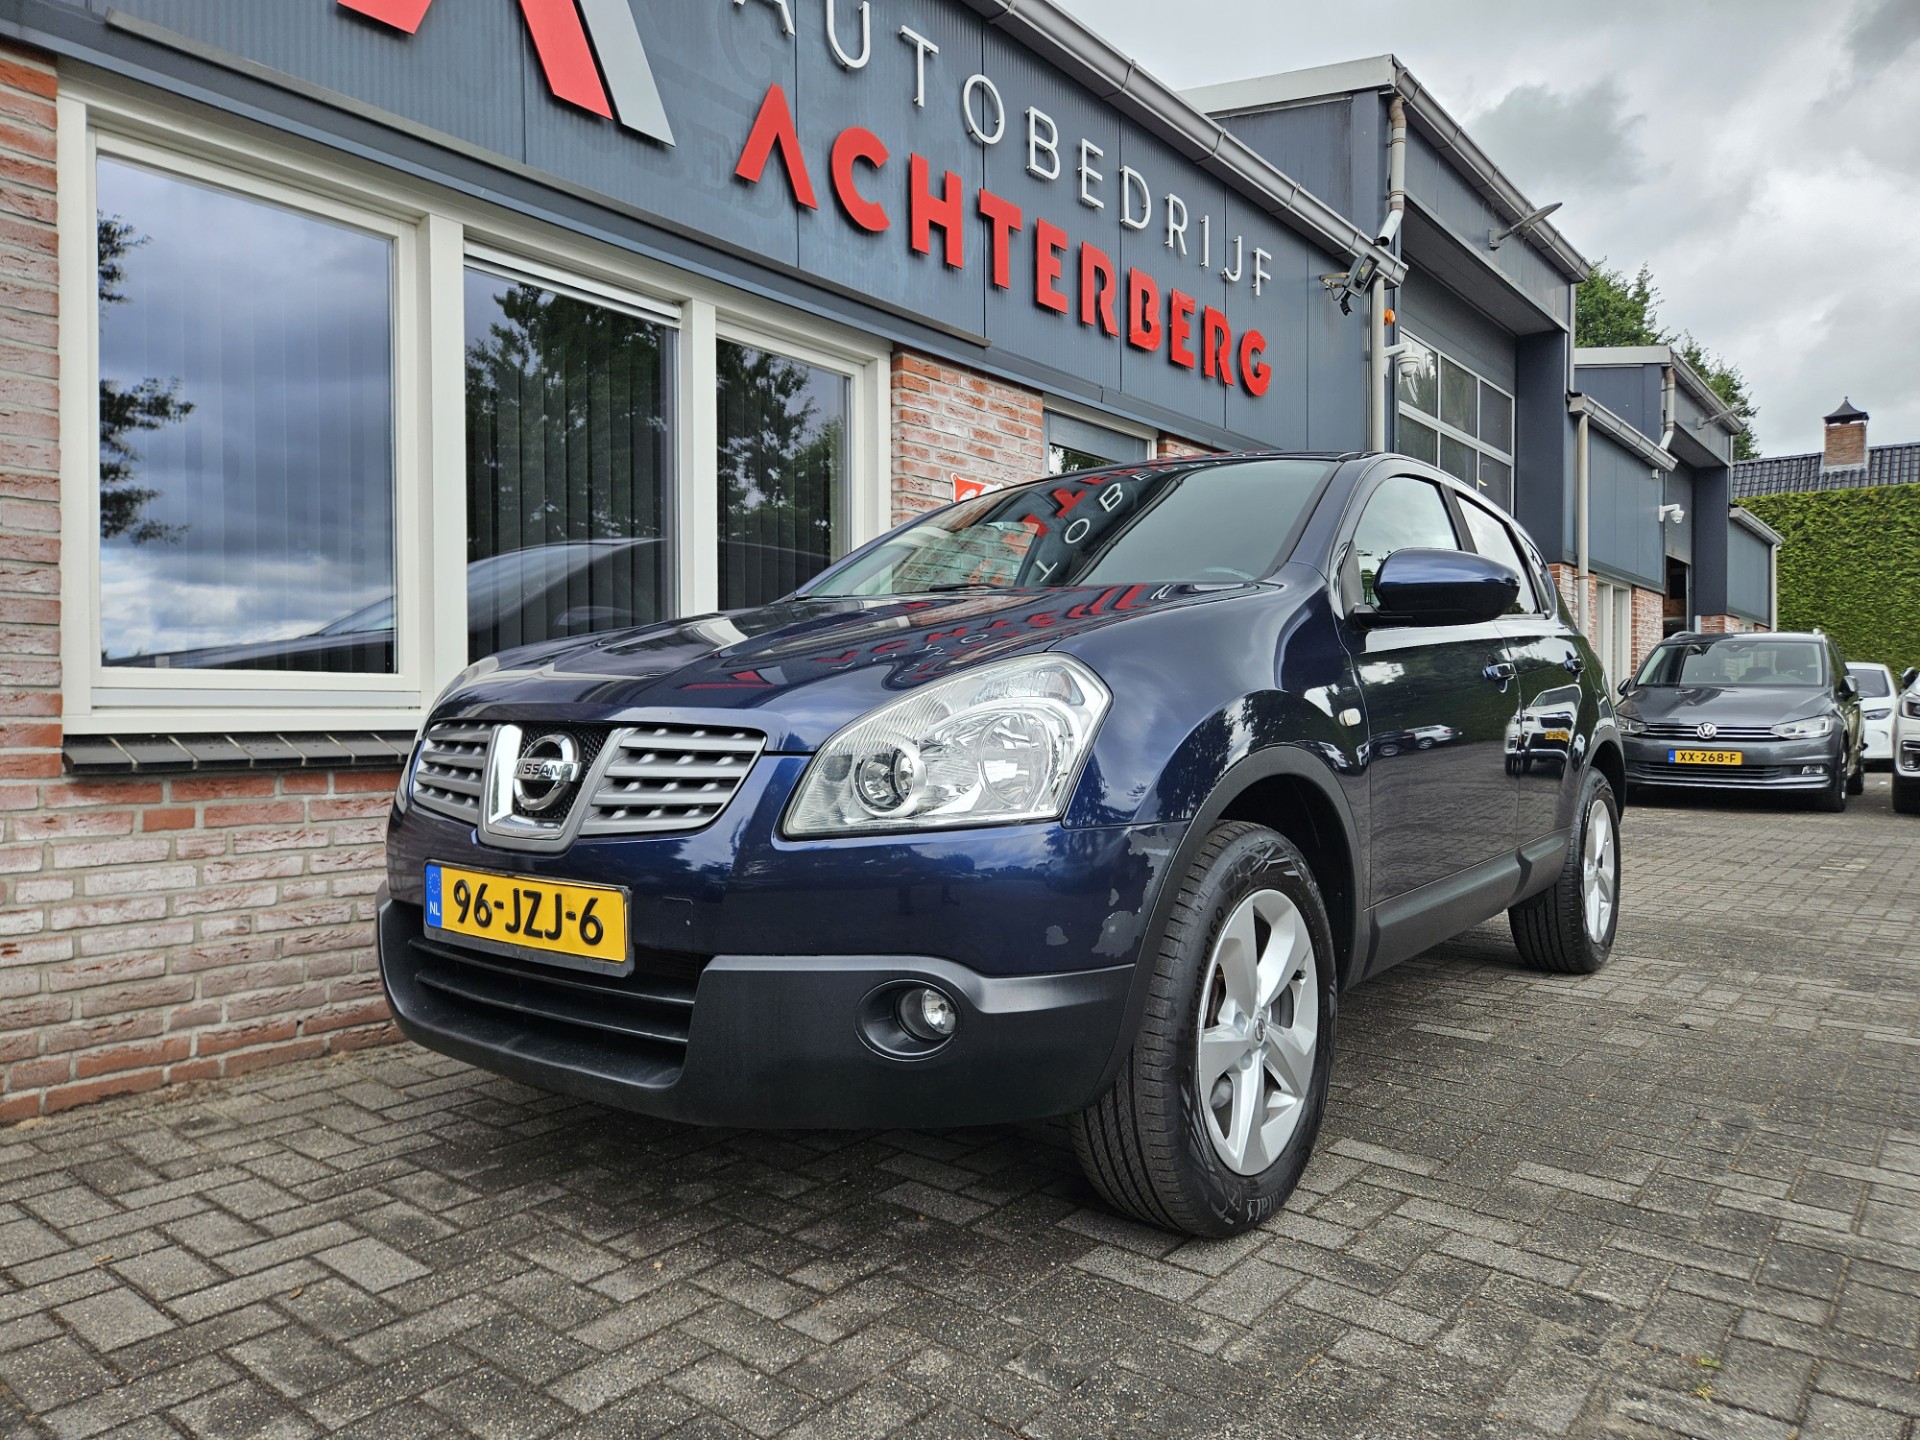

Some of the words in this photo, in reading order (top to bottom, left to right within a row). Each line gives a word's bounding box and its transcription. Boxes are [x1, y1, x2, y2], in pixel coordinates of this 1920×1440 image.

[735, 83, 1273, 397] ACHTERBERG
[1679, 751, 1737, 763] XX-268-F
[429, 901, 441, 917] NL
[453, 879, 604, 946] 96-JZJ-6
